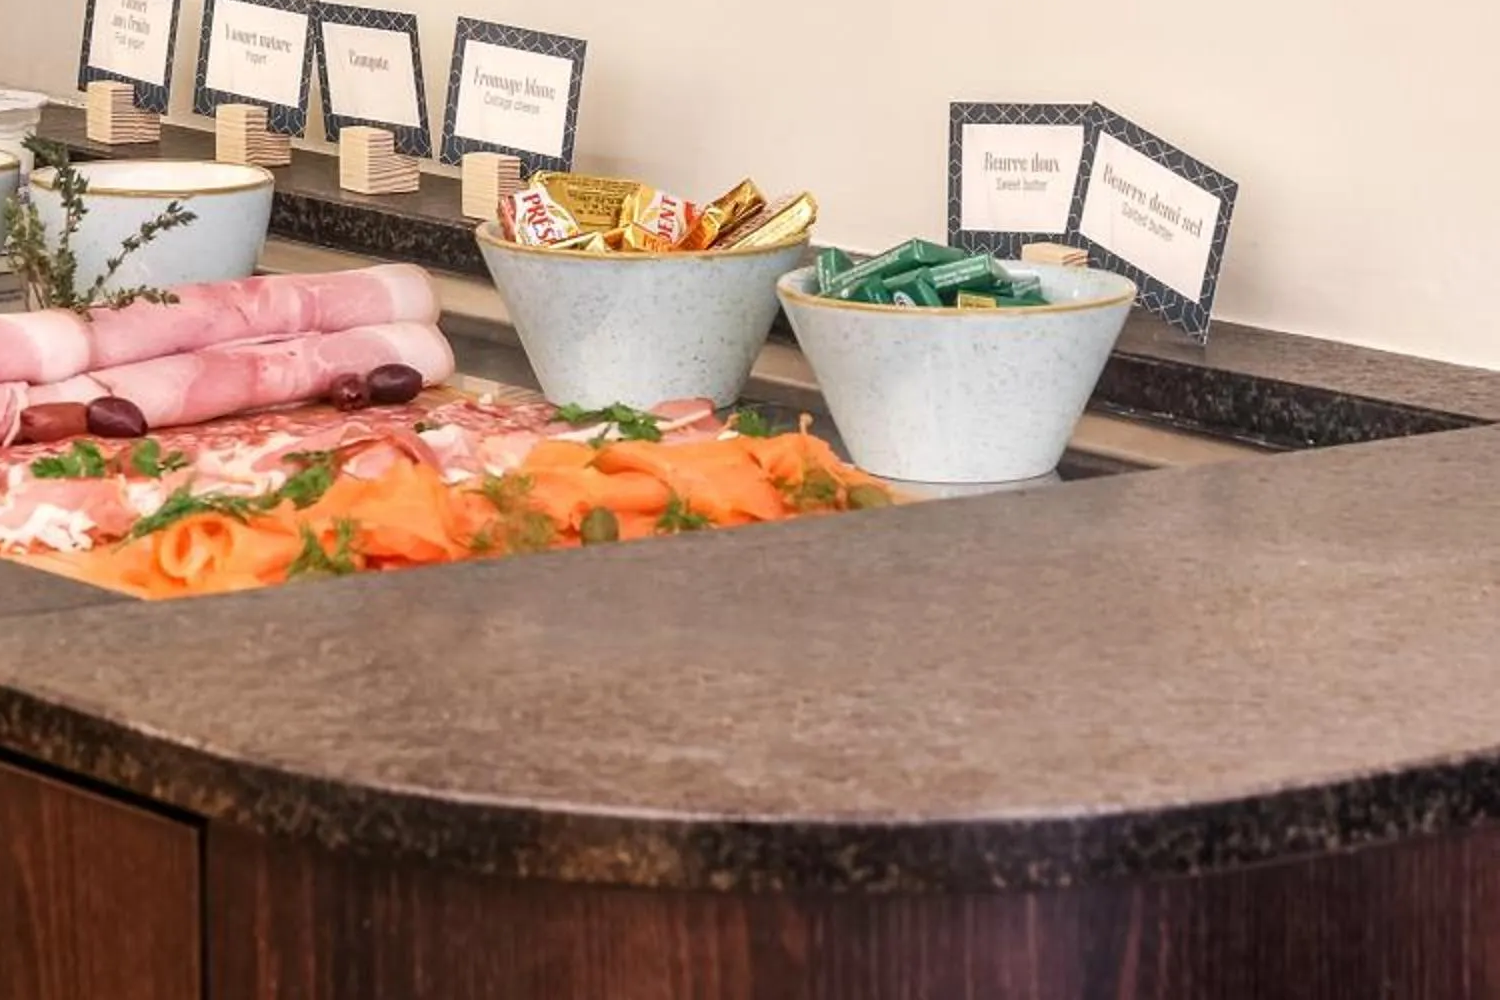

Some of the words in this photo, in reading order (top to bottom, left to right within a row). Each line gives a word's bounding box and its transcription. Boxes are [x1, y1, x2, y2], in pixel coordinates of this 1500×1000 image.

[983, 151, 1028, 172] Beurre
[1031, 152, 1061, 173] doux
[1103, 163, 1147, 205] Beurre
